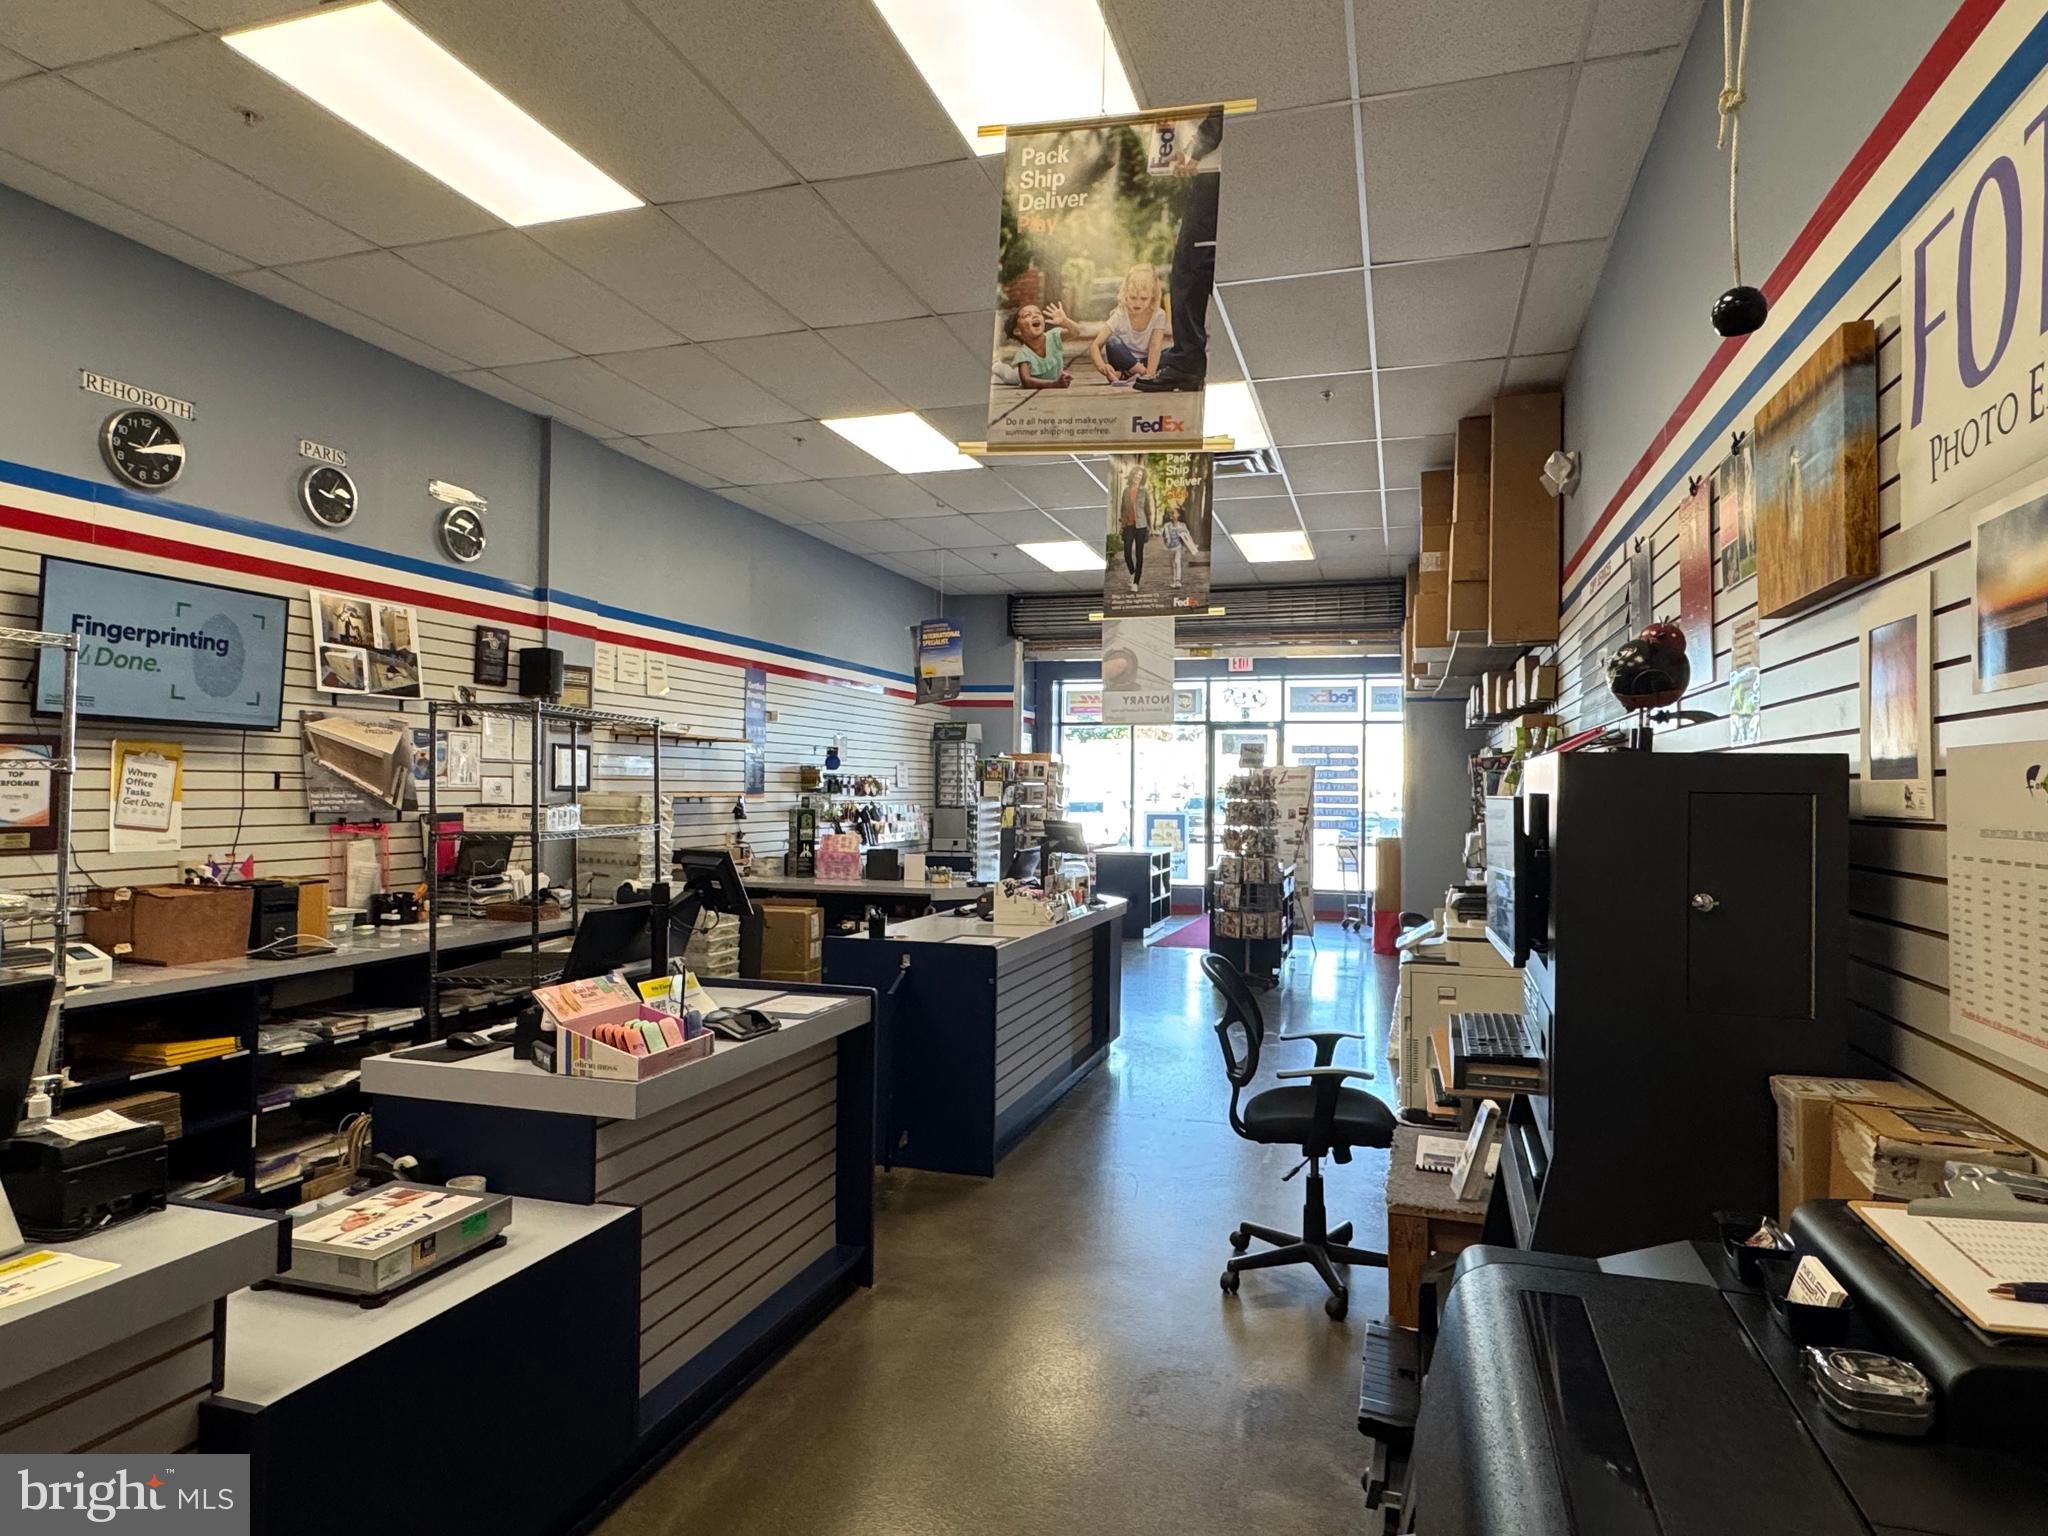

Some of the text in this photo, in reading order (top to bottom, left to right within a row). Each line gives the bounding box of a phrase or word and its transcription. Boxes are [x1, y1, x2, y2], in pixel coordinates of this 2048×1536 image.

[1021, 145, 1070, 167] Pack
[1019, 169, 1066, 191] Ship
[1018, 192, 1088, 212] Deliver
[86, 373, 192, 418] REHOBOTH
[1005, 416, 1118, 426] Do it all here and make your
[1132, 415, 1184, 433] FedEx
[1040, 426, 1075, 437] shipping
[1929, 392, 2019, 484] PHOTO
[304, 442, 345, 465] PARIS
[1166, 453, 1192, 464] Pack
[1166, 464, 1190, 476] Ship
[1165, 477, 1202, 488] Deliver
[71, 613, 229, 657] Fingerprinting
[94, 646, 161, 673] Done.
[127, 767, 158, 779] Where
[126, 777, 154, 788] Office
[125, 787, 151, 797] Tasks
[122, 797, 139, 806] Get
[352, 1211, 434, 1247] Notary
